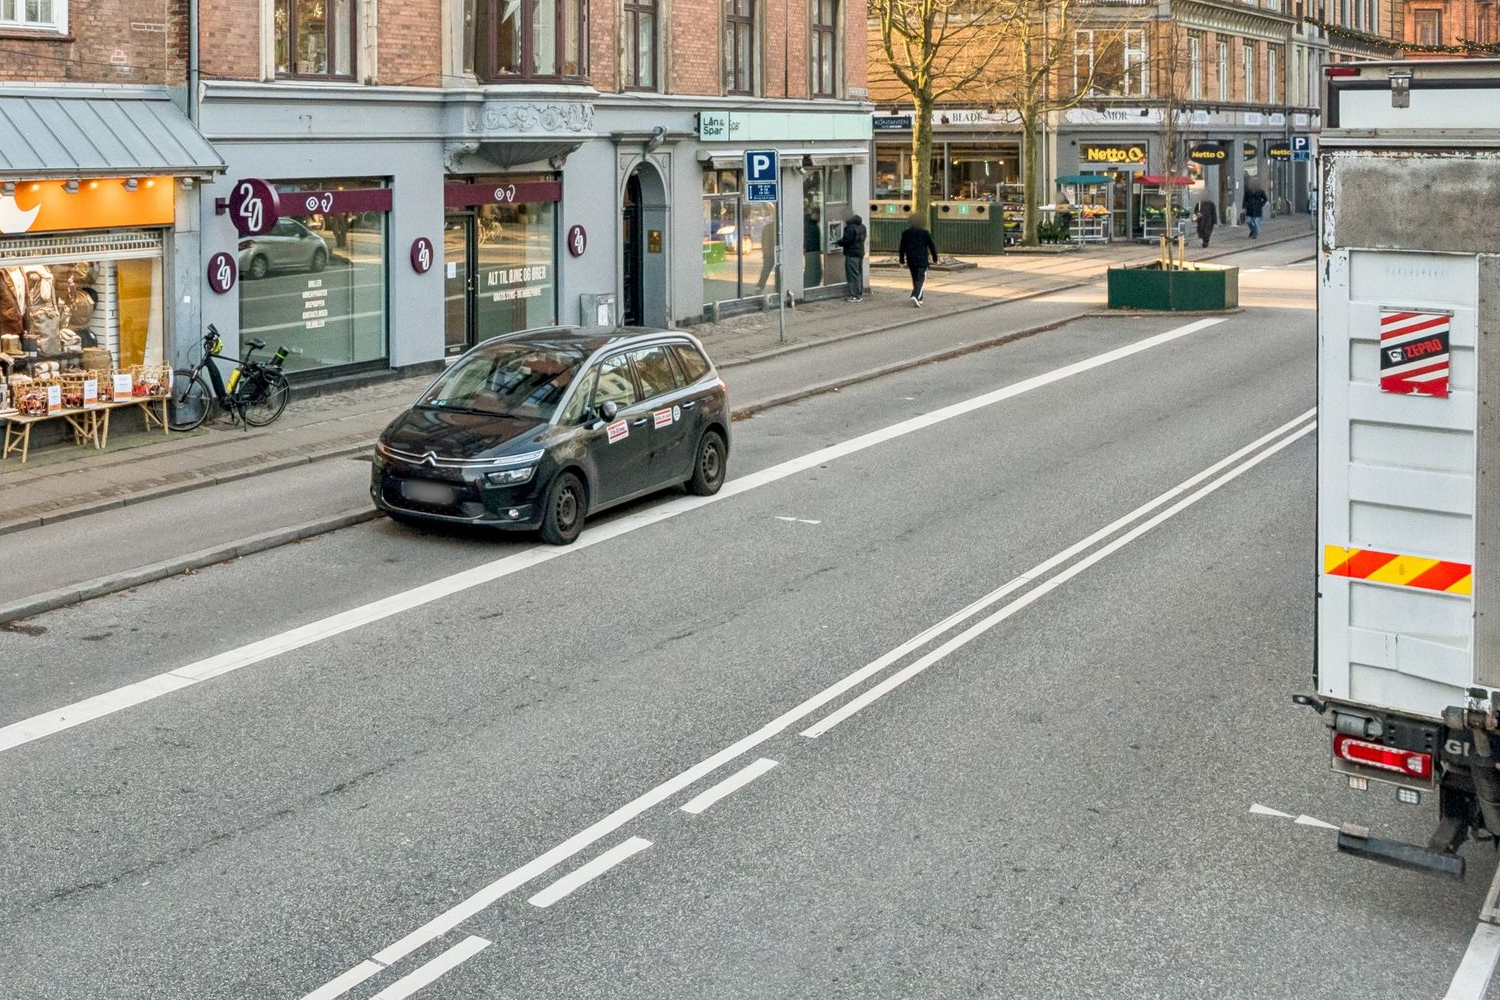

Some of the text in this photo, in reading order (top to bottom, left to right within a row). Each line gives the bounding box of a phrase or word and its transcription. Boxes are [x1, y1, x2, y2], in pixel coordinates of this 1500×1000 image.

[703, 116, 719, 126] Lån
[703, 126, 723, 136] Spar
[1295, 138, 1306, 150] P
[1088, 148, 1127, 161] Netto
[753, 155, 770, 178] P
[488, 271, 498, 286] ALT
[498, 270, 508, 285] TIL
[1404, 338, 1443, 359] ZEPRO
